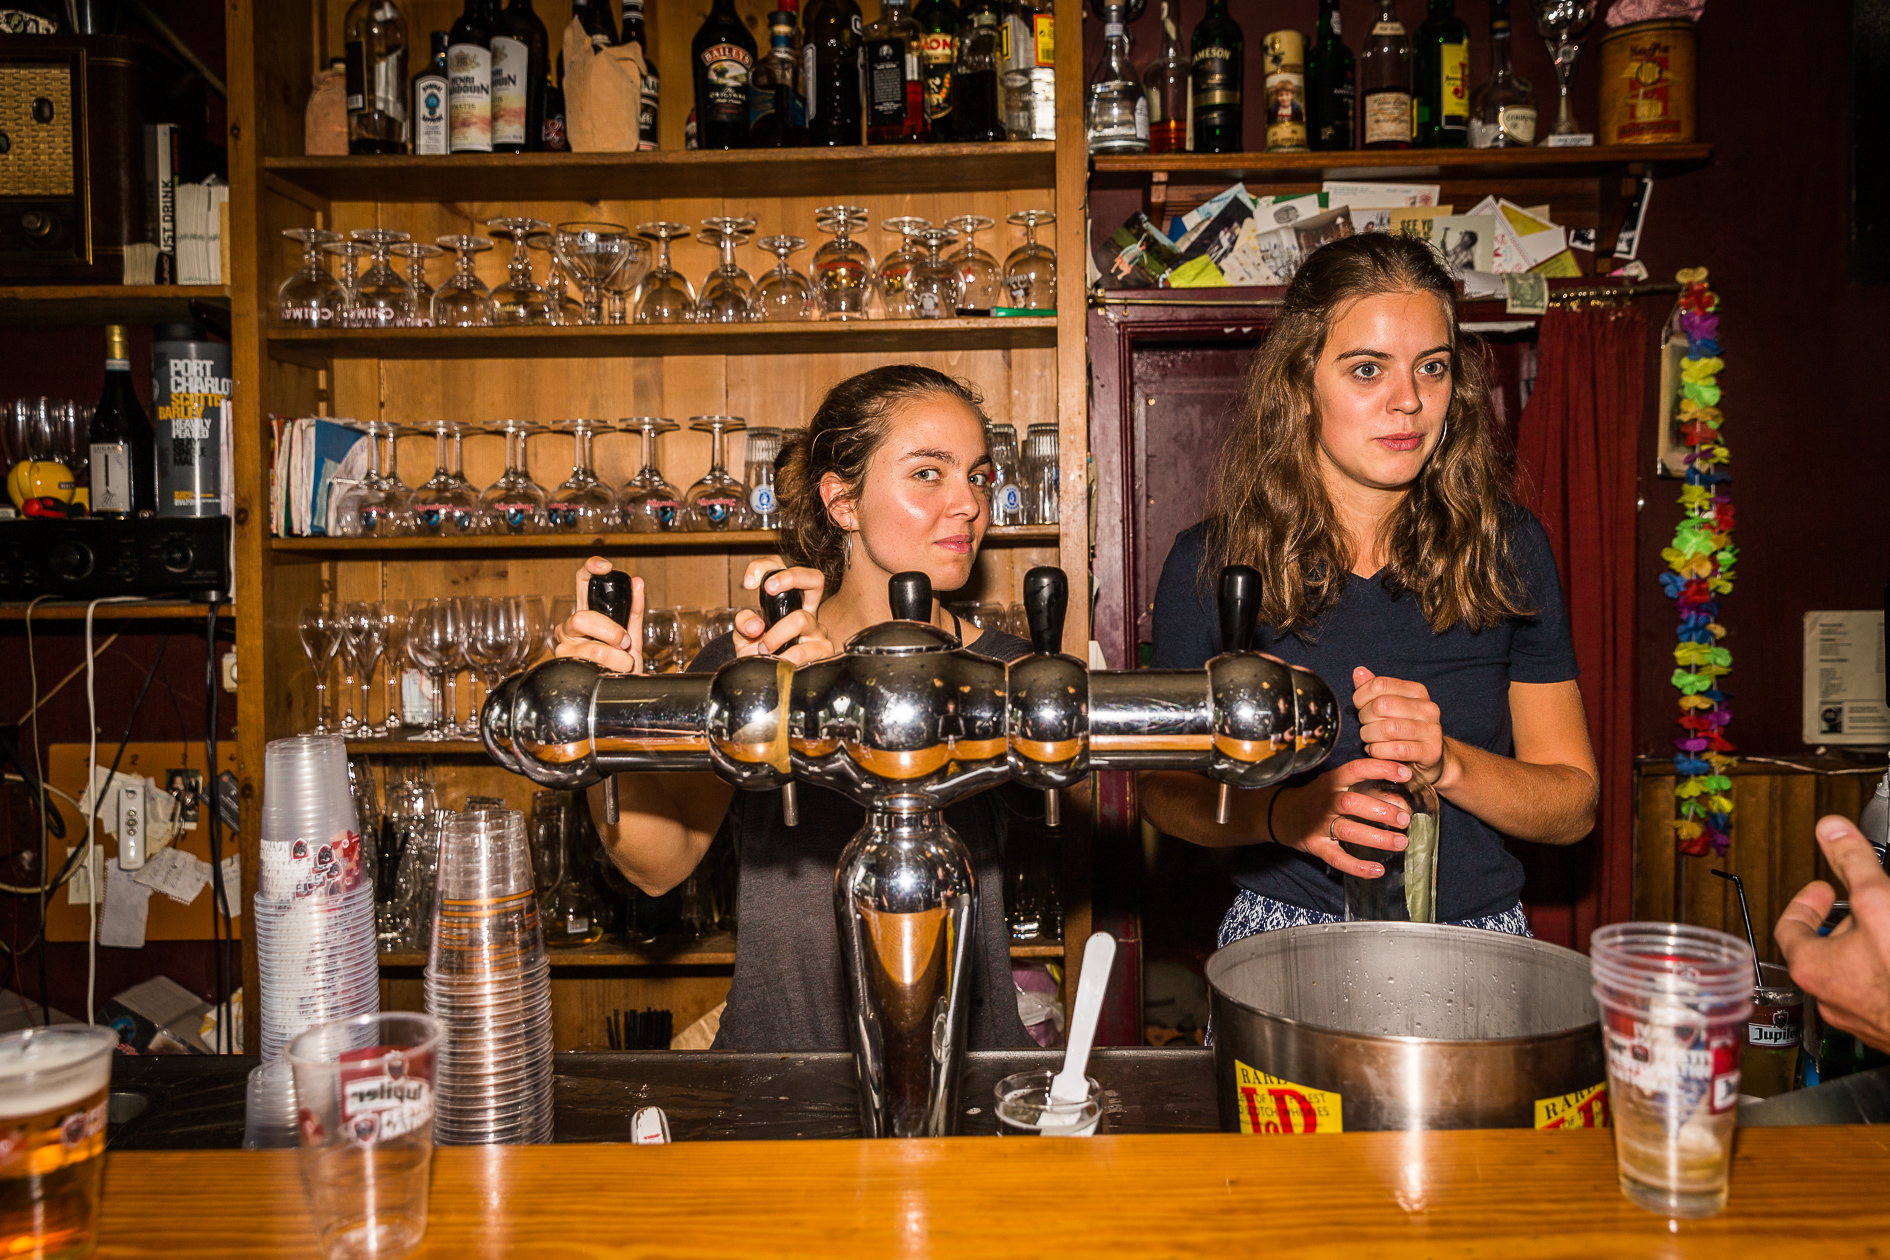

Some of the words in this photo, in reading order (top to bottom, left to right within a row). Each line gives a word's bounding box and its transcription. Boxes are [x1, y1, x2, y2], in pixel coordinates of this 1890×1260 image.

[704, 46, 750, 63] BAILEYS
[170, 359, 214, 377] PORT
[171, 377, 233, 393] CHARLOT
[171, 393, 224, 407] SCOTTIS
[158, 406, 203, 420] BARLEY
